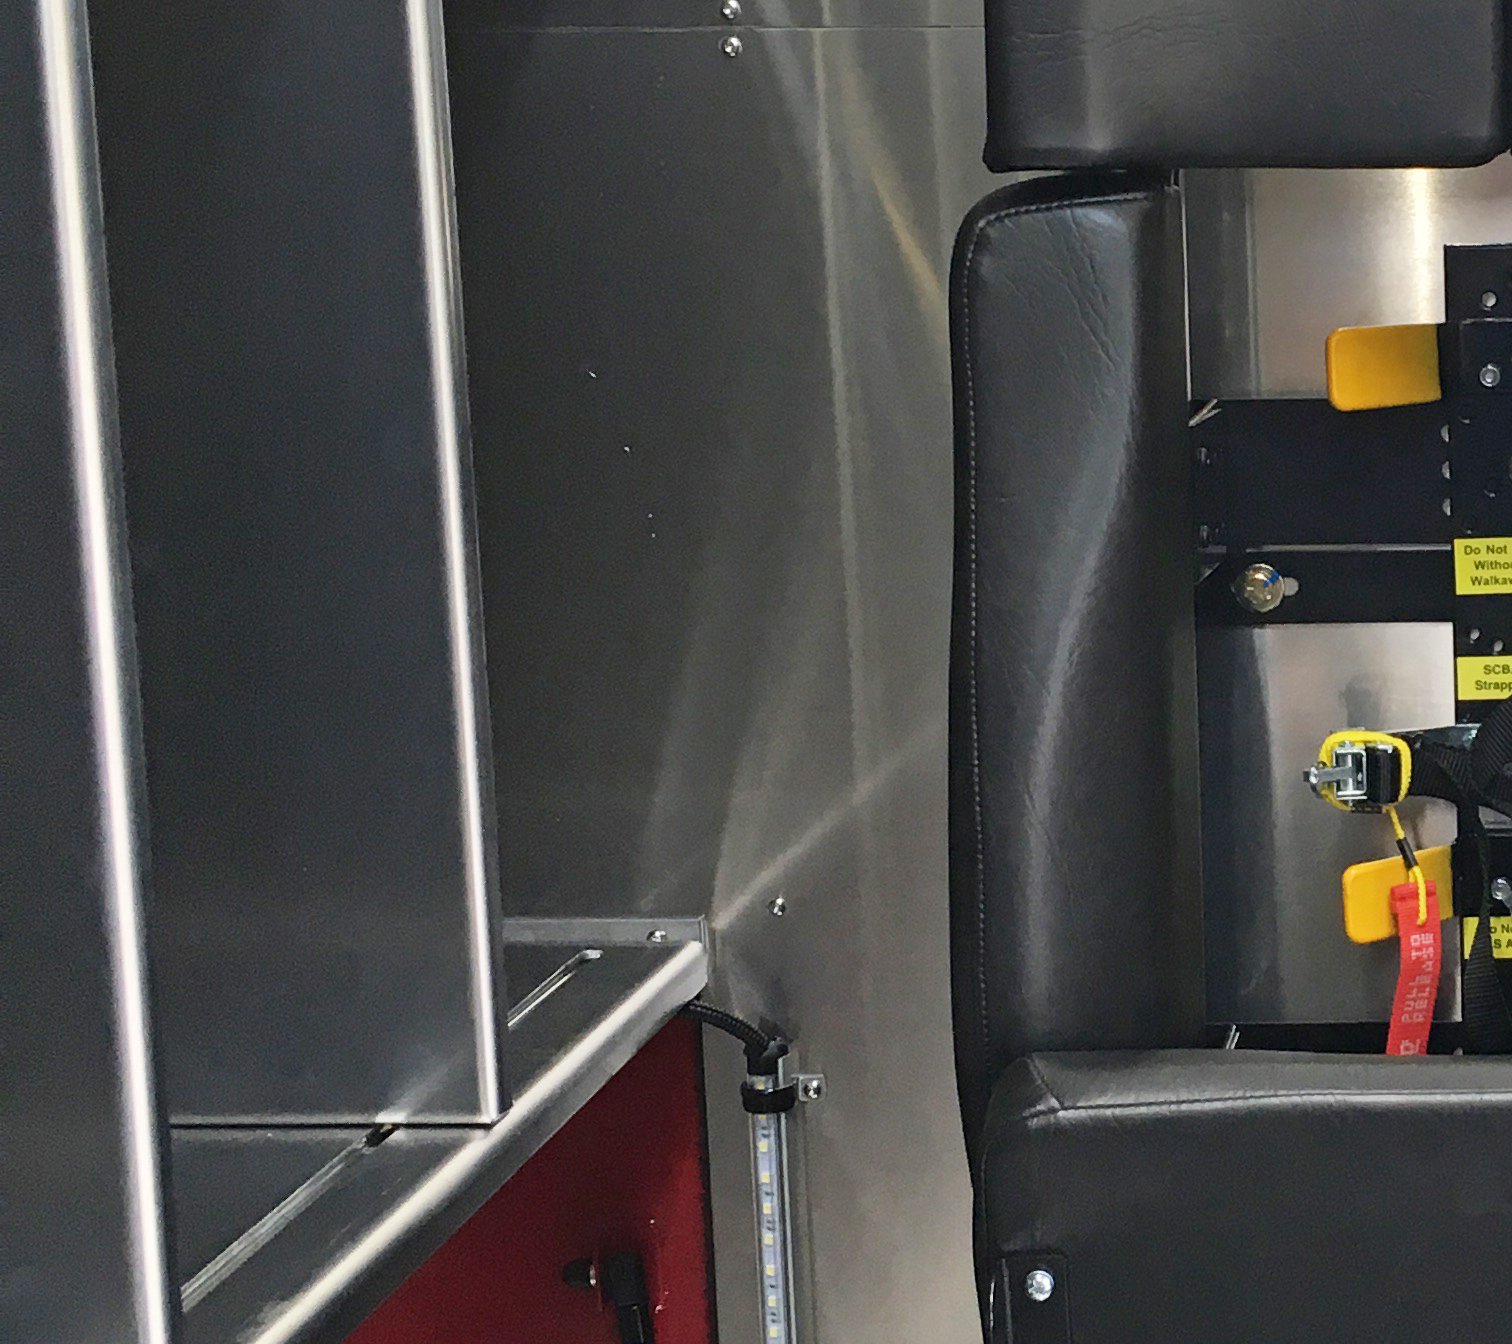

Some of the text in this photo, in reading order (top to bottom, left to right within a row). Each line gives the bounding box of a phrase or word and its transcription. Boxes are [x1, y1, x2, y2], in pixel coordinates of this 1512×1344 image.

[1463, 544, 1482, 556] Do
[1486, 544, 1508, 555] Not
[1410, 933, 1423, 960] TO
[1414, 933, 1435, 1023] RELEASE
[1402, 976, 1420, 1023] PULL
